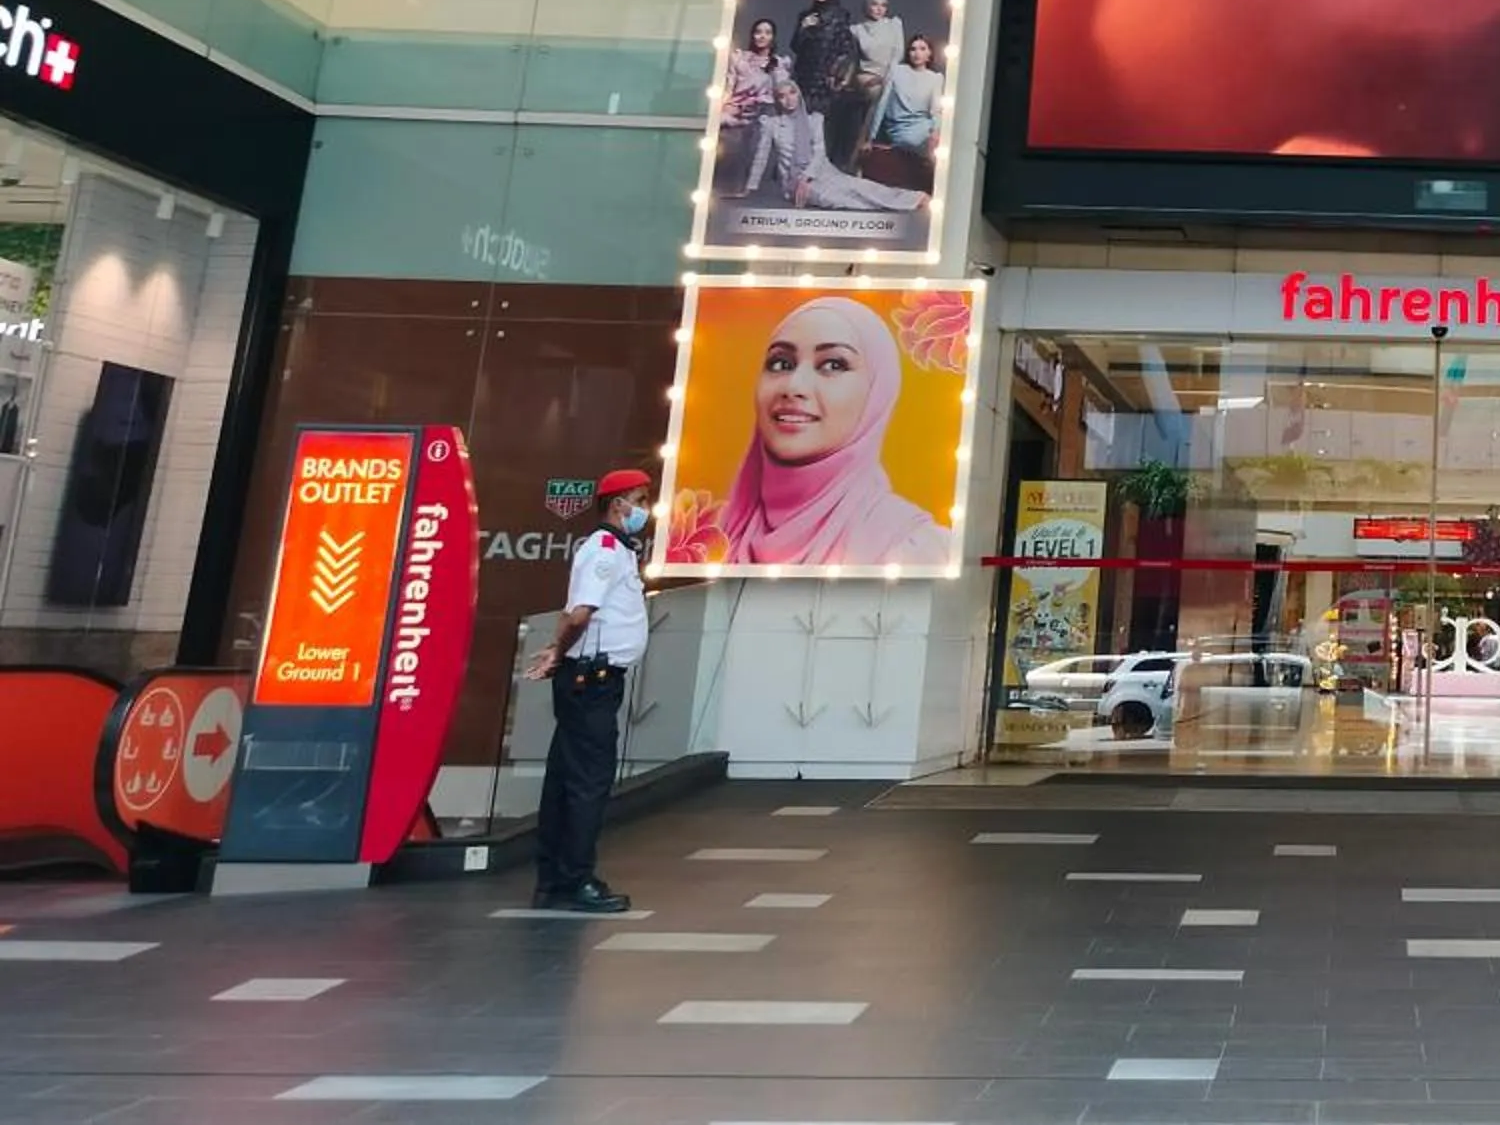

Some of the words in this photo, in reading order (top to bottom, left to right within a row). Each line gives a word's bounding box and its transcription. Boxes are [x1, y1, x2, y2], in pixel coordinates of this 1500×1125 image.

[795, 218, 849, 230] GROUND
[851, 220, 895, 231] FLOOR
[302, 457, 402, 480] BRANDS
[300, 482, 395, 504] OUTLET
[551, 482, 590, 495] TAG
[1021, 539, 1081, 559] LEVEL
[1086, 538, 1095, 557] 1
[388, 502, 449, 703] fahrenheit
[297, 643, 350, 661] Lower
[277, 663, 344, 682] Ground
[353, 665, 360, 682] 1
